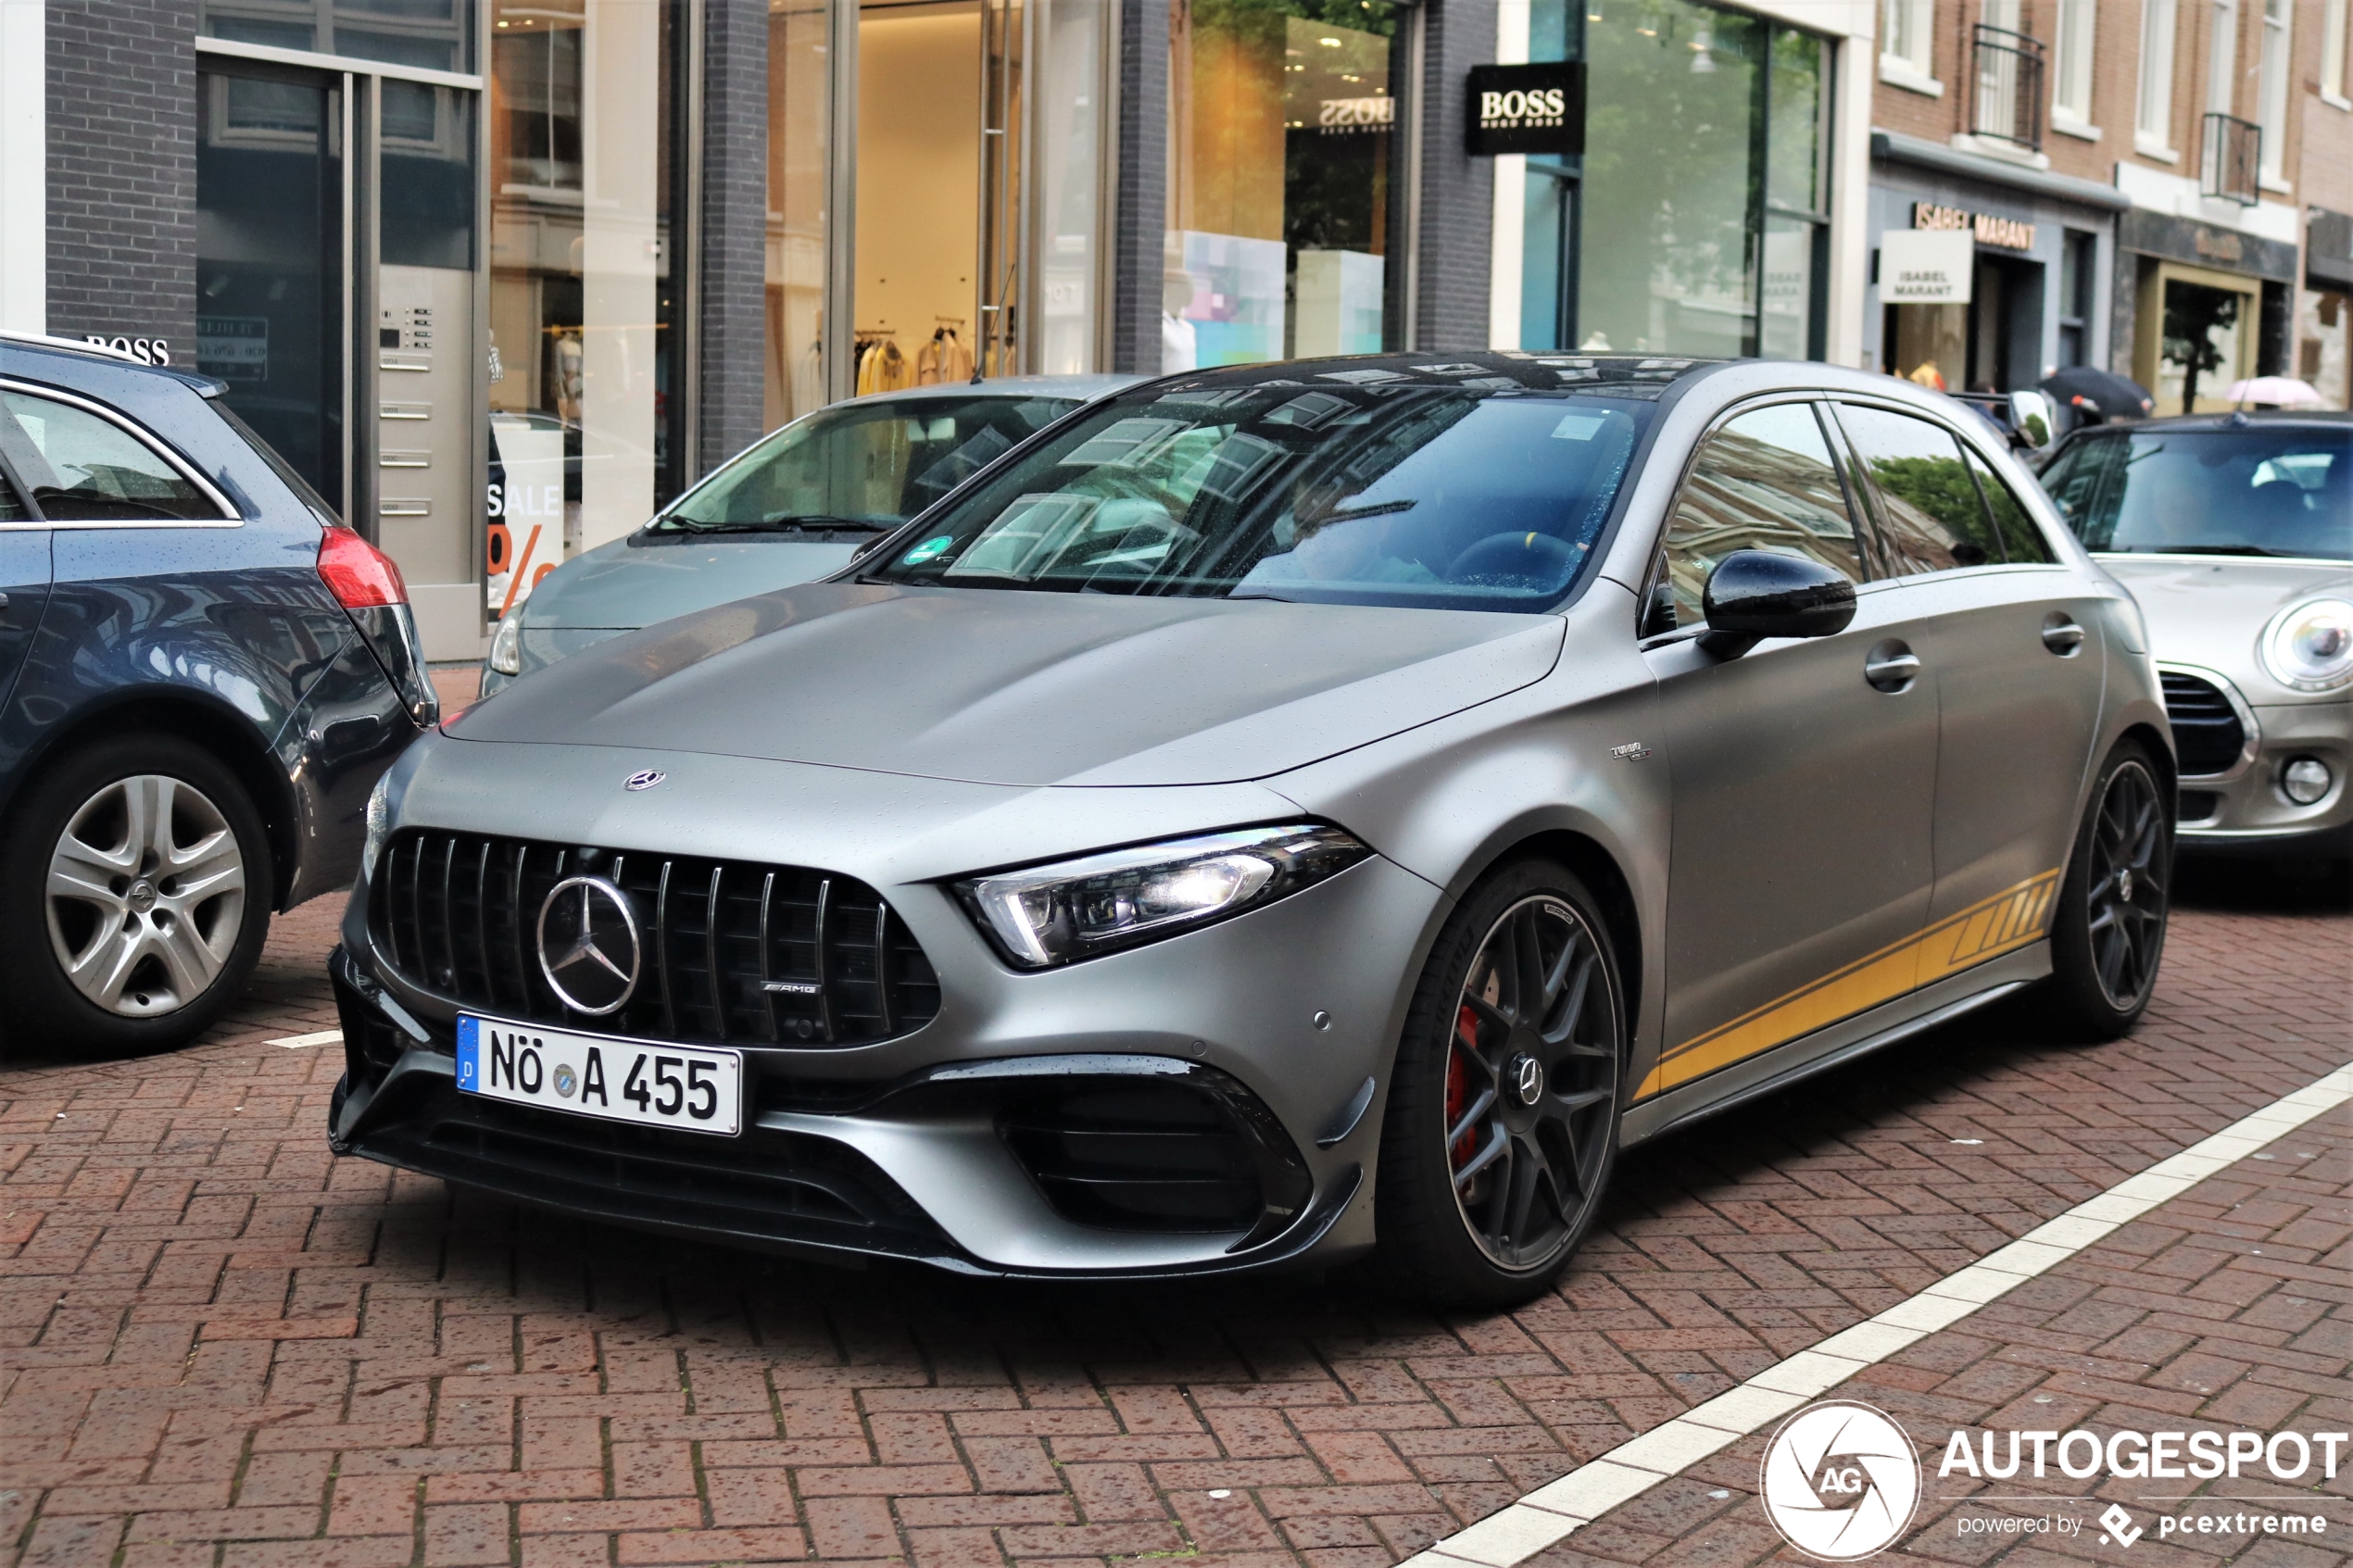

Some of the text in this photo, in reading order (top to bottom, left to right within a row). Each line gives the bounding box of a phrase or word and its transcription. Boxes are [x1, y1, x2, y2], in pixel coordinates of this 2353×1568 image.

[1480, 89, 1565, 119] BOSS
[1974, 213, 2036, 251] MARANT
[1894, 284, 1953, 295] MARANT
[1899, 270, 1949, 282] ISABEL
[86, 335, 170, 367] OSS
[487, 483, 560, 517] SALE
[1610, 742, 1642, 756] TURBO
[464, 1061, 472, 1077] D
[491, 1030, 543, 1094] NÖ
[581, 1047, 608, 1107] A
[623, 1053, 717, 1120] 455
